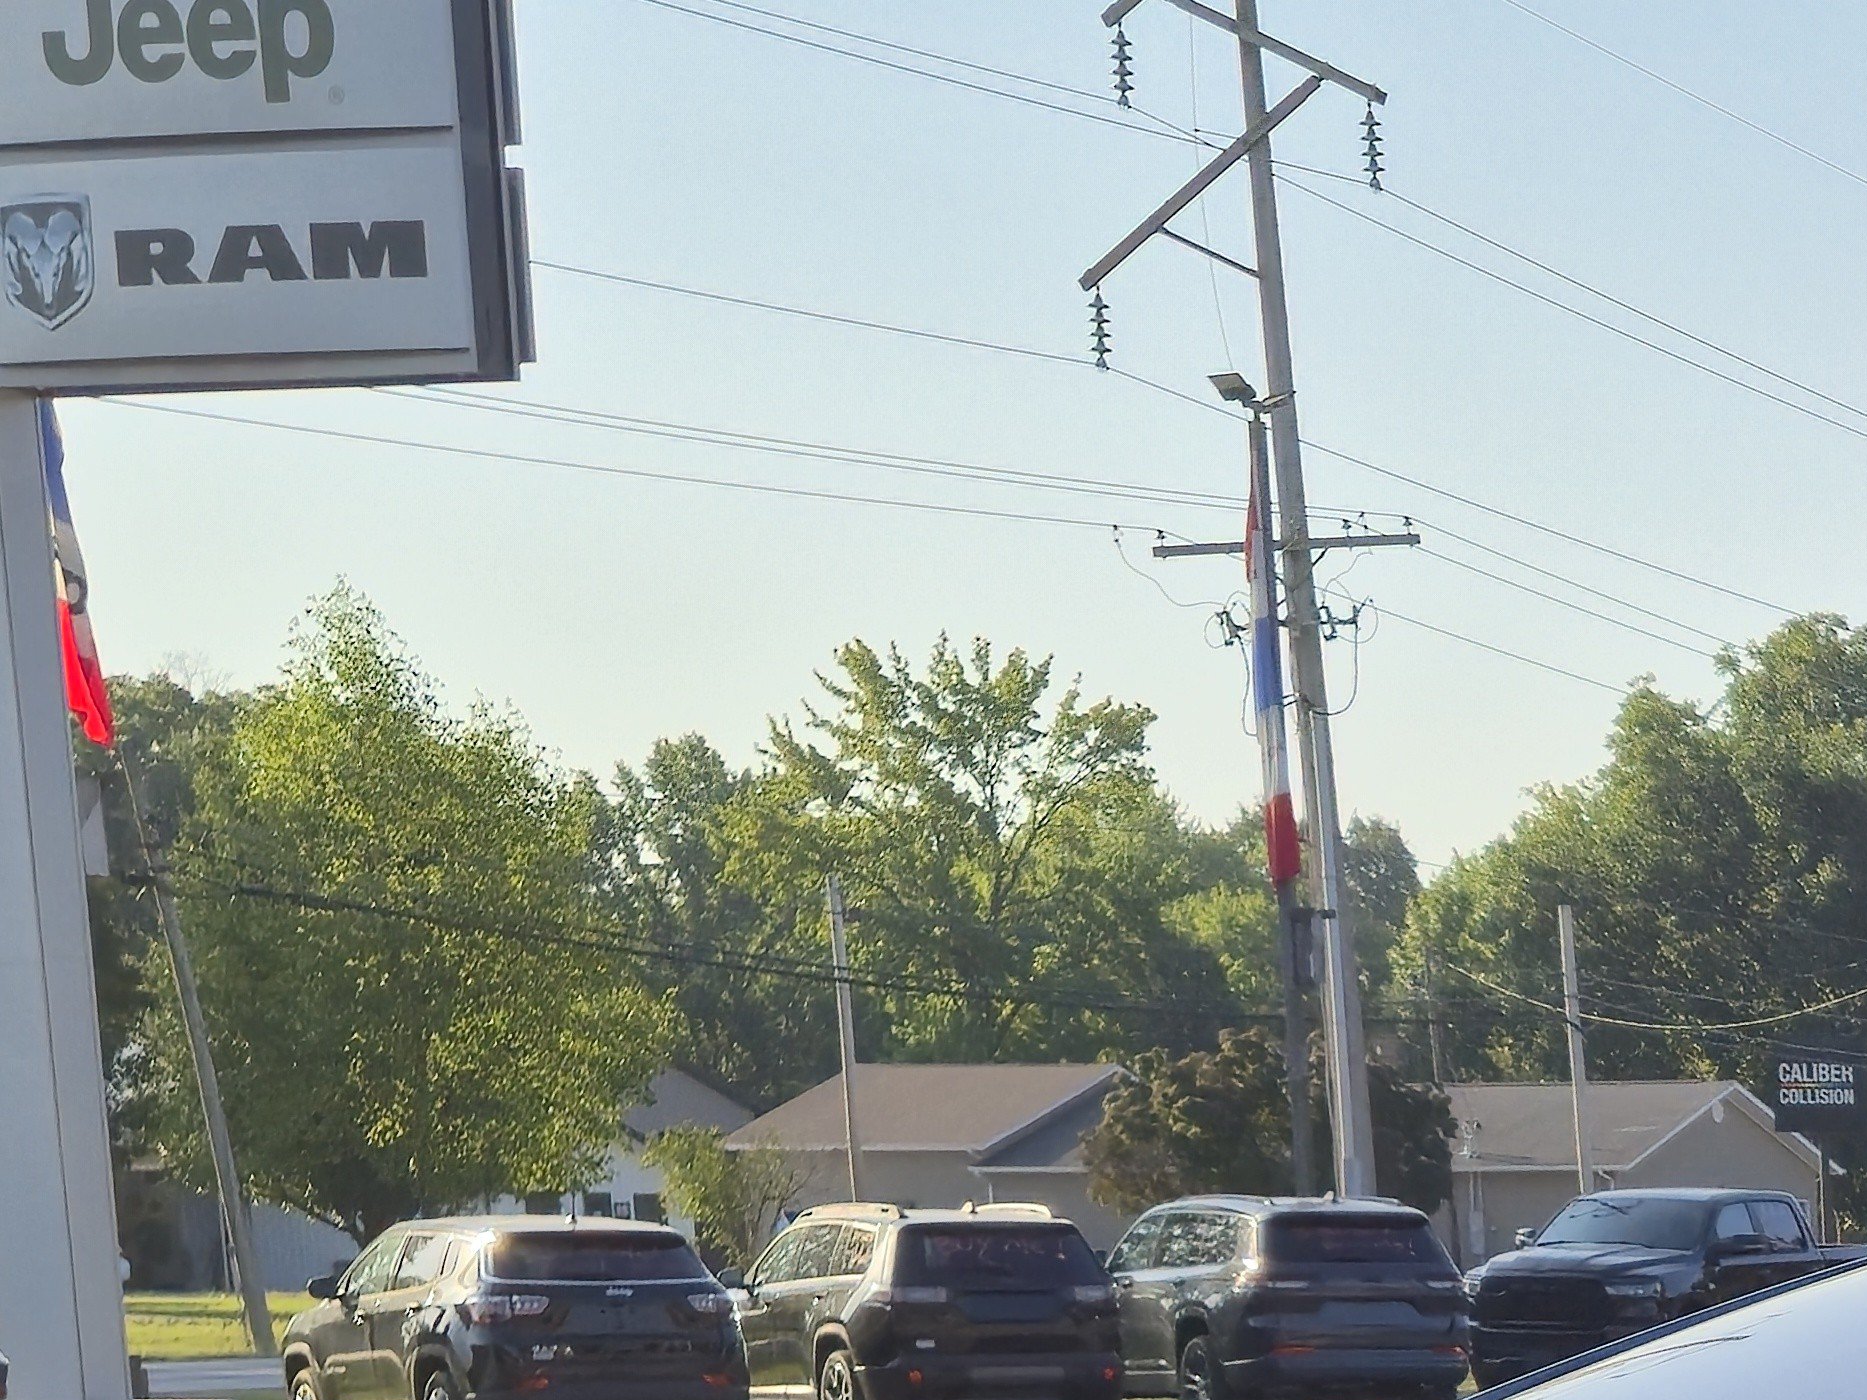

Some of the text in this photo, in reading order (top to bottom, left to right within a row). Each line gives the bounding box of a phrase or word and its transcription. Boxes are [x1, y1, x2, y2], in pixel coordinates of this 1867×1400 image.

[42, 0, 334, 103] Jeep
[114, 220, 427, 287] RAM
[1778, 1062, 1854, 1083] CALIBER
[1779, 1088, 1855, 1105] COLLISION
